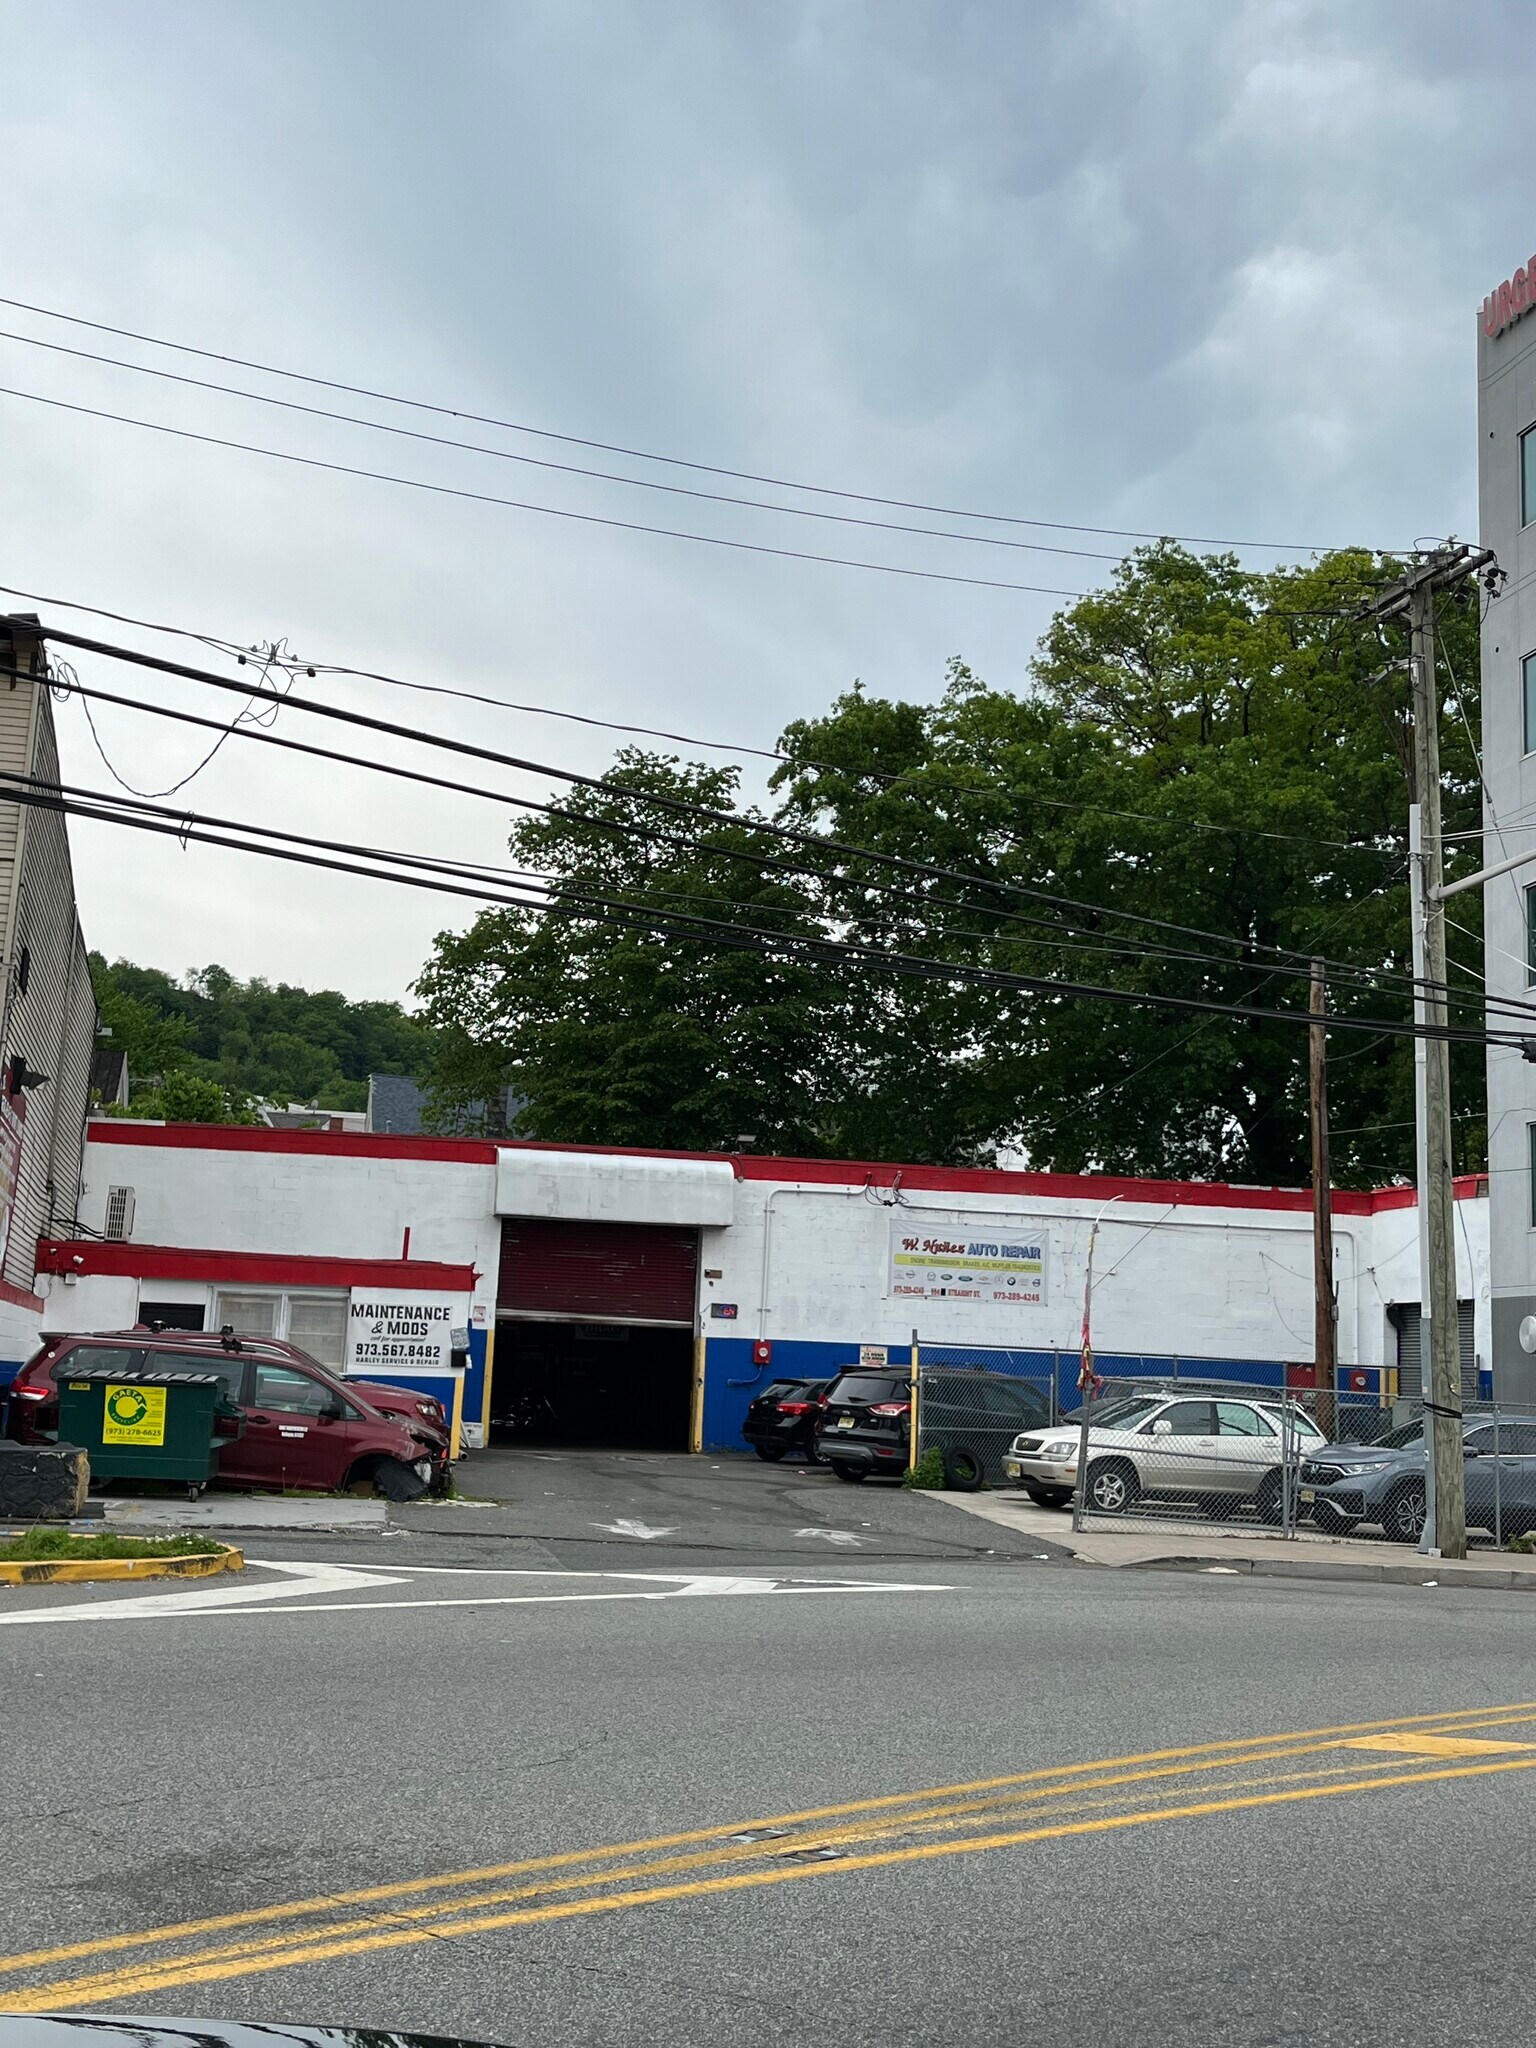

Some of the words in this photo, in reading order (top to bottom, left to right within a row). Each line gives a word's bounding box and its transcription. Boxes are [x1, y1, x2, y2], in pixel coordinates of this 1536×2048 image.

[902, 1237, 919, 1251] W.
[967, 1242, 998, 1257] AUTO
[1001, 1244, 1041, 1259] REPAIR
[993, 1292, 1040, 1301] 973-289-4245
[351, 1304, 450, 1320] MAINTENANCE
[371, 1321, 383, 1334] &
[387, 1321, 428, 1335] MODS
[356, 1343, 440, 1357] 973.567.8482
[381, 1357, 408, 1365] SERVICE
[112, 1389, 143, 1402] GAETA
[105, 1427, 125, 1436] (973)
